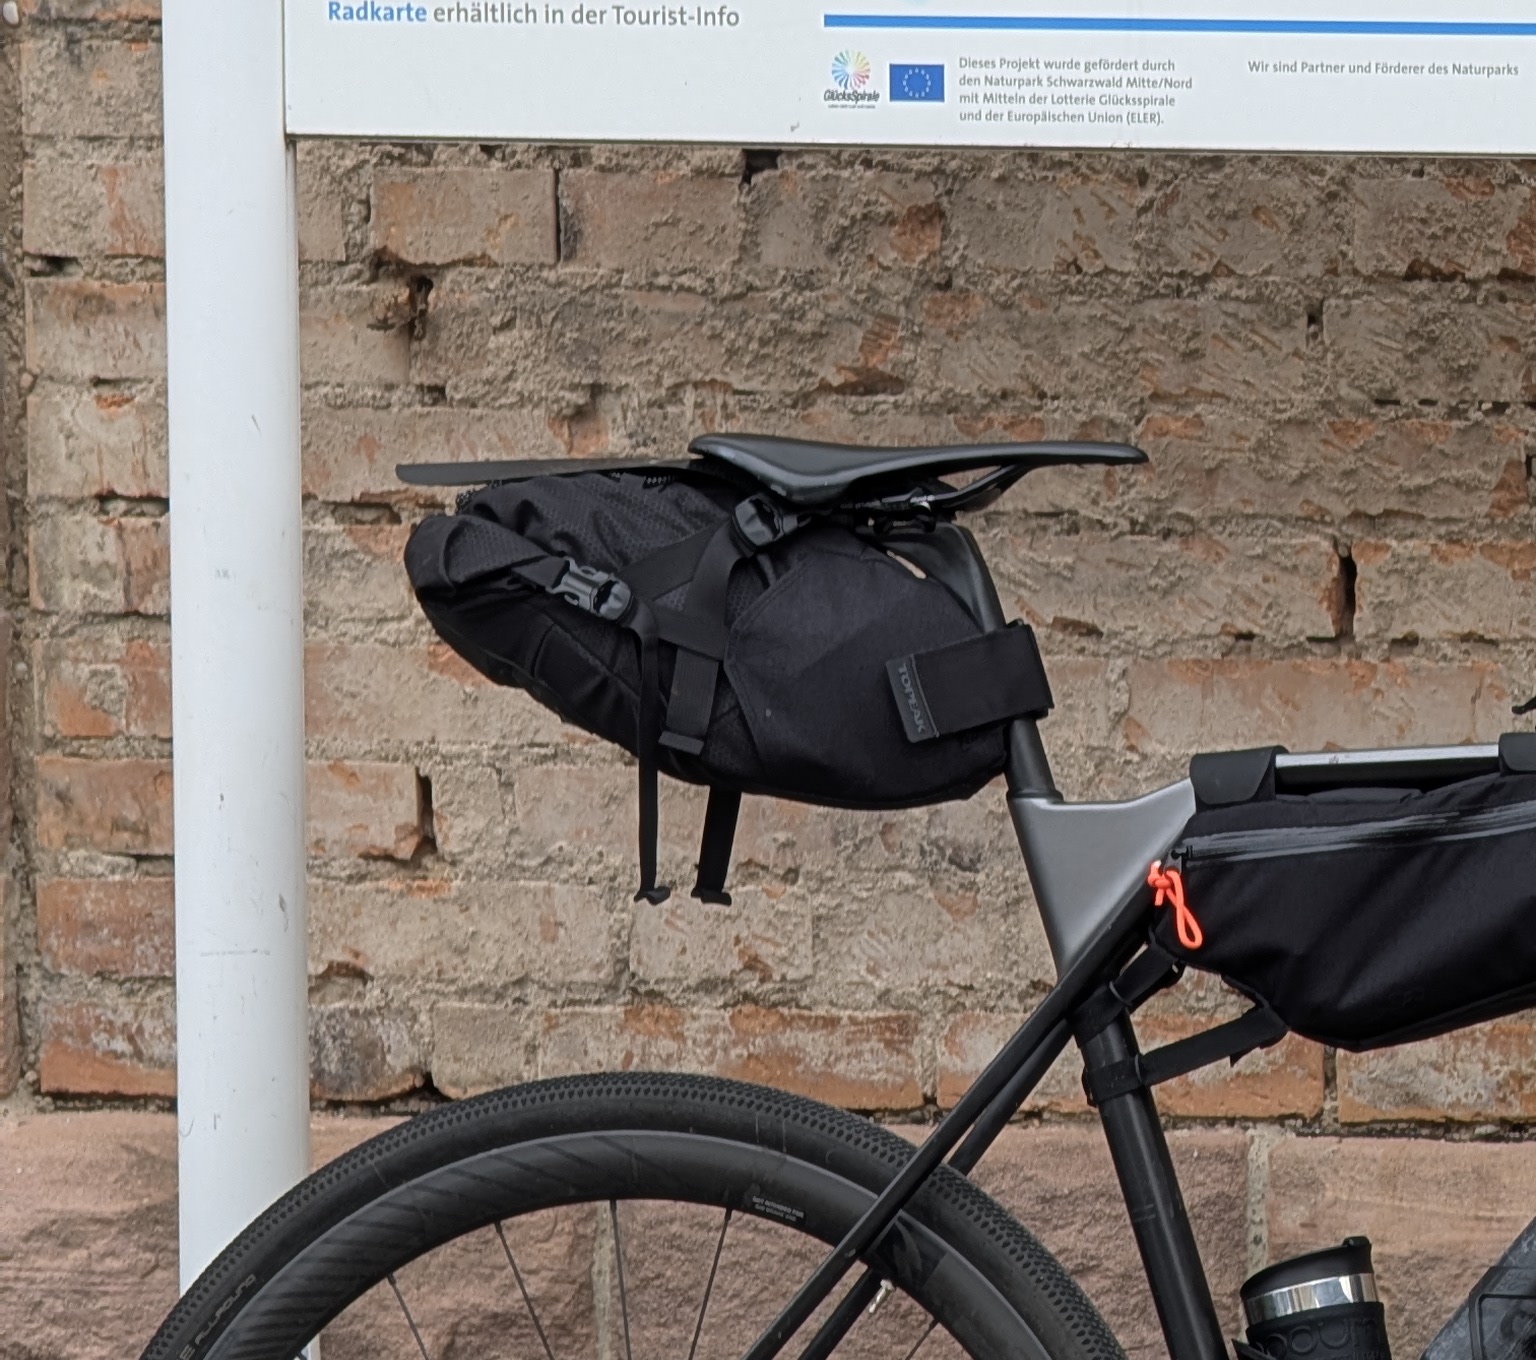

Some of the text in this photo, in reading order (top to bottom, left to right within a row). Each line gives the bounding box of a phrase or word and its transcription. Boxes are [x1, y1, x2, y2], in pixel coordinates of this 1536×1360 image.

[329, 1, 739, 26] Radkarte erhältlich in der Tourist-Info
[959, 57, 1174, 73] Dieses Projekt wurde gefördert durch
[1248, 61, 1518, 78] Wir sind Partner und Förderer des Naturparks
[959, 75, 1192, 89] den Naturpark Schwarzwald Mitte/Nord
[960, 93, 1175, 108] mit Mitteln der Lotterie Glücksspirale
[960, 110, 1163, 126] und der Europäischen Union (ELER).
[899, 663, 926, 733] TOPEAK
